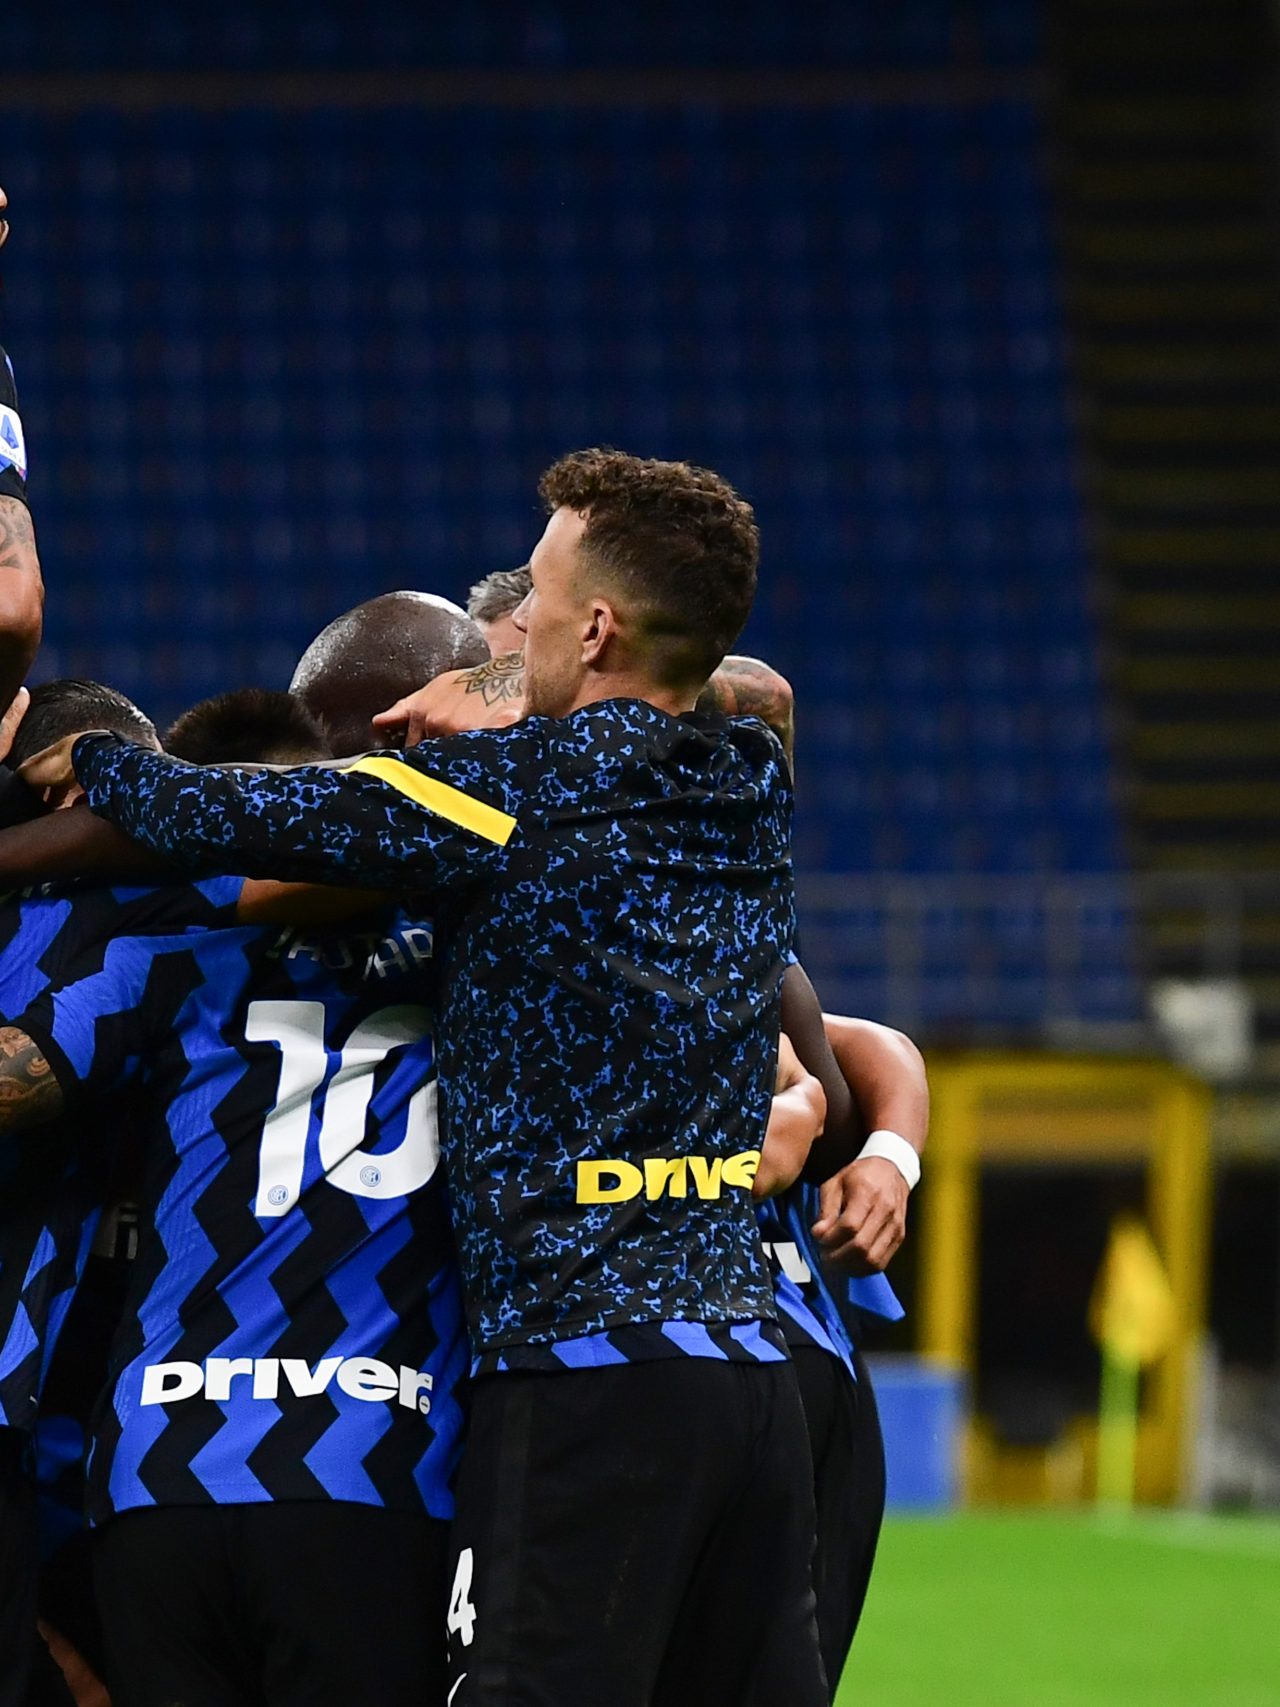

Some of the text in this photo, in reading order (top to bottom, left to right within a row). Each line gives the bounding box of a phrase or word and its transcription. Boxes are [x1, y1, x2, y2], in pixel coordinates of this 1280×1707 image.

[266, 926, 434, 981] LAUTAR
[245, 1000, 440, 1217] 10
[576, 1150, 762, 1204] Drive
